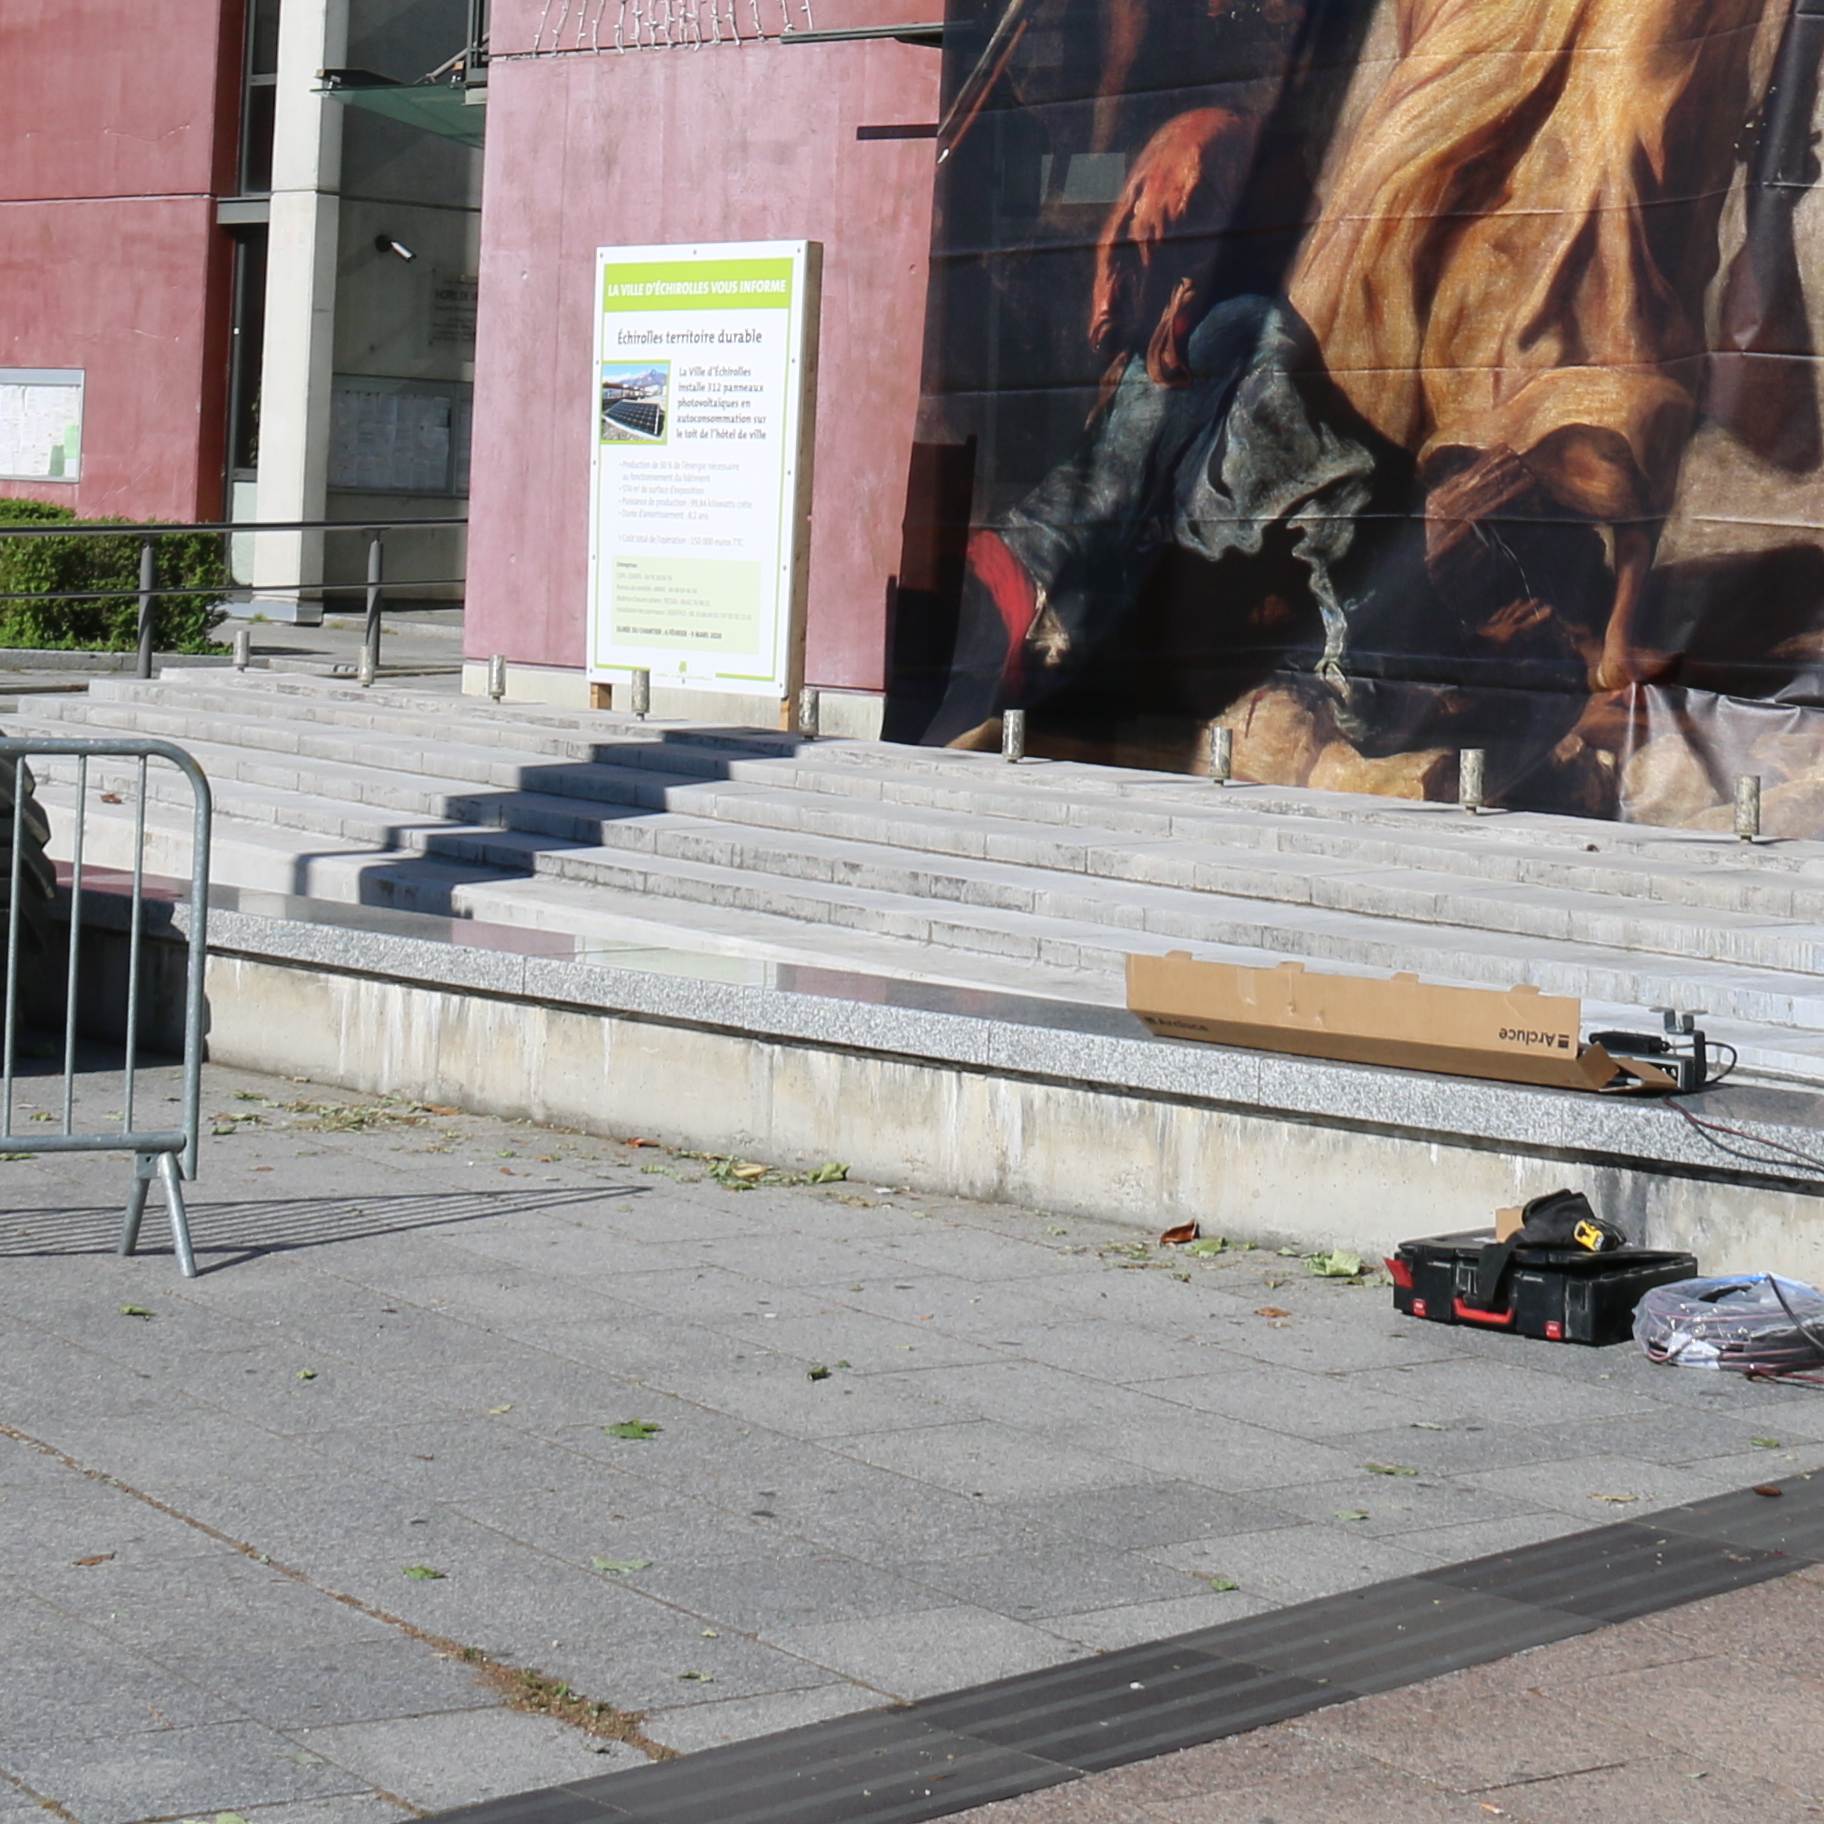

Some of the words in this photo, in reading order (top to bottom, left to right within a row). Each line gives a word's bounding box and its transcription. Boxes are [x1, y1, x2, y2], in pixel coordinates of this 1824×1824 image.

[608, 283, 619, 297] LA
[621, 282, 644, 297] VILLE
[711, 279, 738, 294] VOUS
[740, 278, 787, 293] INFORME
[618, 328, 663, 345] Échirolles
[666, 329, 715, 344] territoire
[717, 328, 762, 344] durable
[723, 383, 764, 395] panneaux
[677, 412, 751, 424] autoconsommation
[753, 415, 767, 424] sur
[699, 428, 708, 439] de
[738, 428, 747, 440] de
[749, 428, 767, 440] ville
[1498, 1028, 1556, 1048] Arcluce
